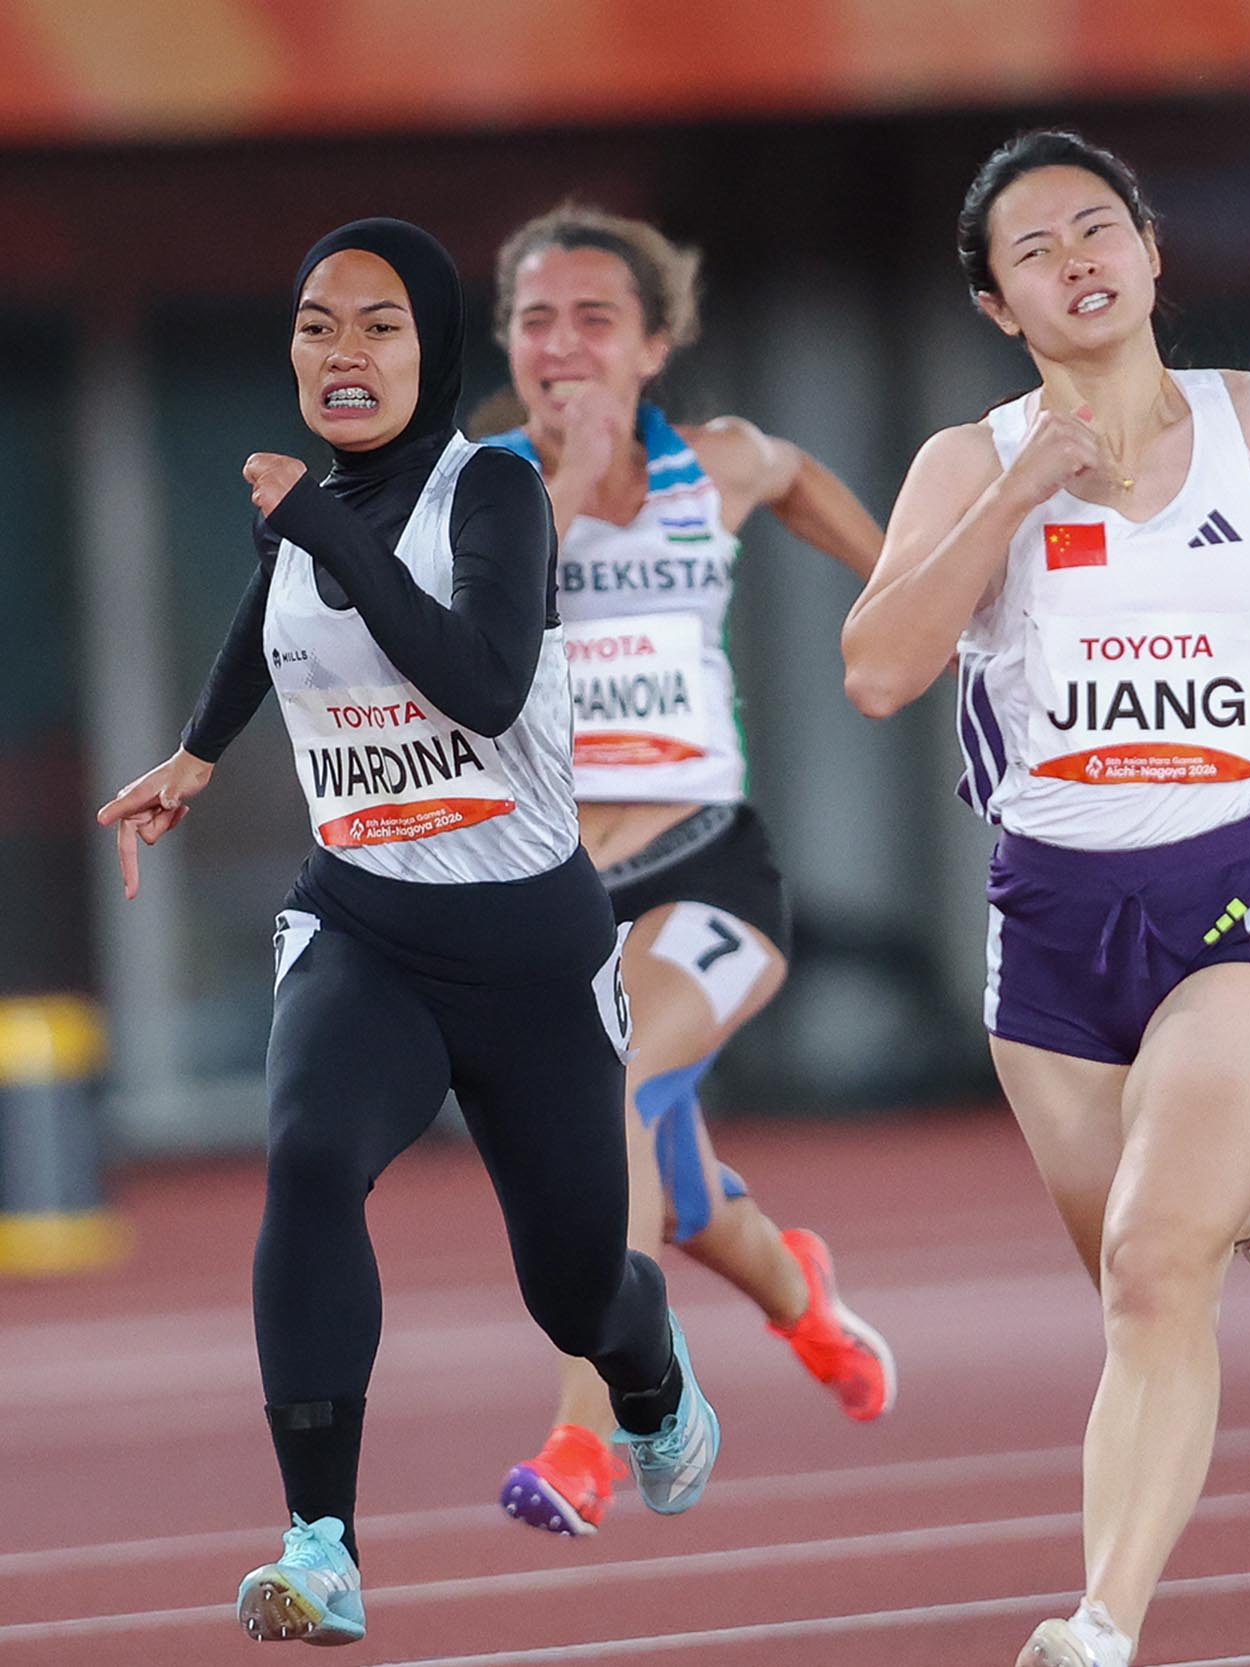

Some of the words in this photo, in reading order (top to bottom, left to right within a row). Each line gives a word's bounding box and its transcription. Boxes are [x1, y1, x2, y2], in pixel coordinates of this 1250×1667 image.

[562, 556, 733, 592] BEKISTA
[564, 634, 657, 662] OYOTA
[1080, 634, 1213, 660] TOYOTA
[573, 669, 690, 720] HANOVA
[1047, 676, 1246, 731] JIANG
[327, 700, 427, 729] TOYOTA
[309, 729, 484, 798] WARDINA
[1105, 766, 1186, 779] Aichi-Nagoya
[1188, 764, 1217, 777] 2026
[416, 808, 446, 821] Games
[434, 812, 463, 827] 2026
[696, 915, 742, 973] 7
